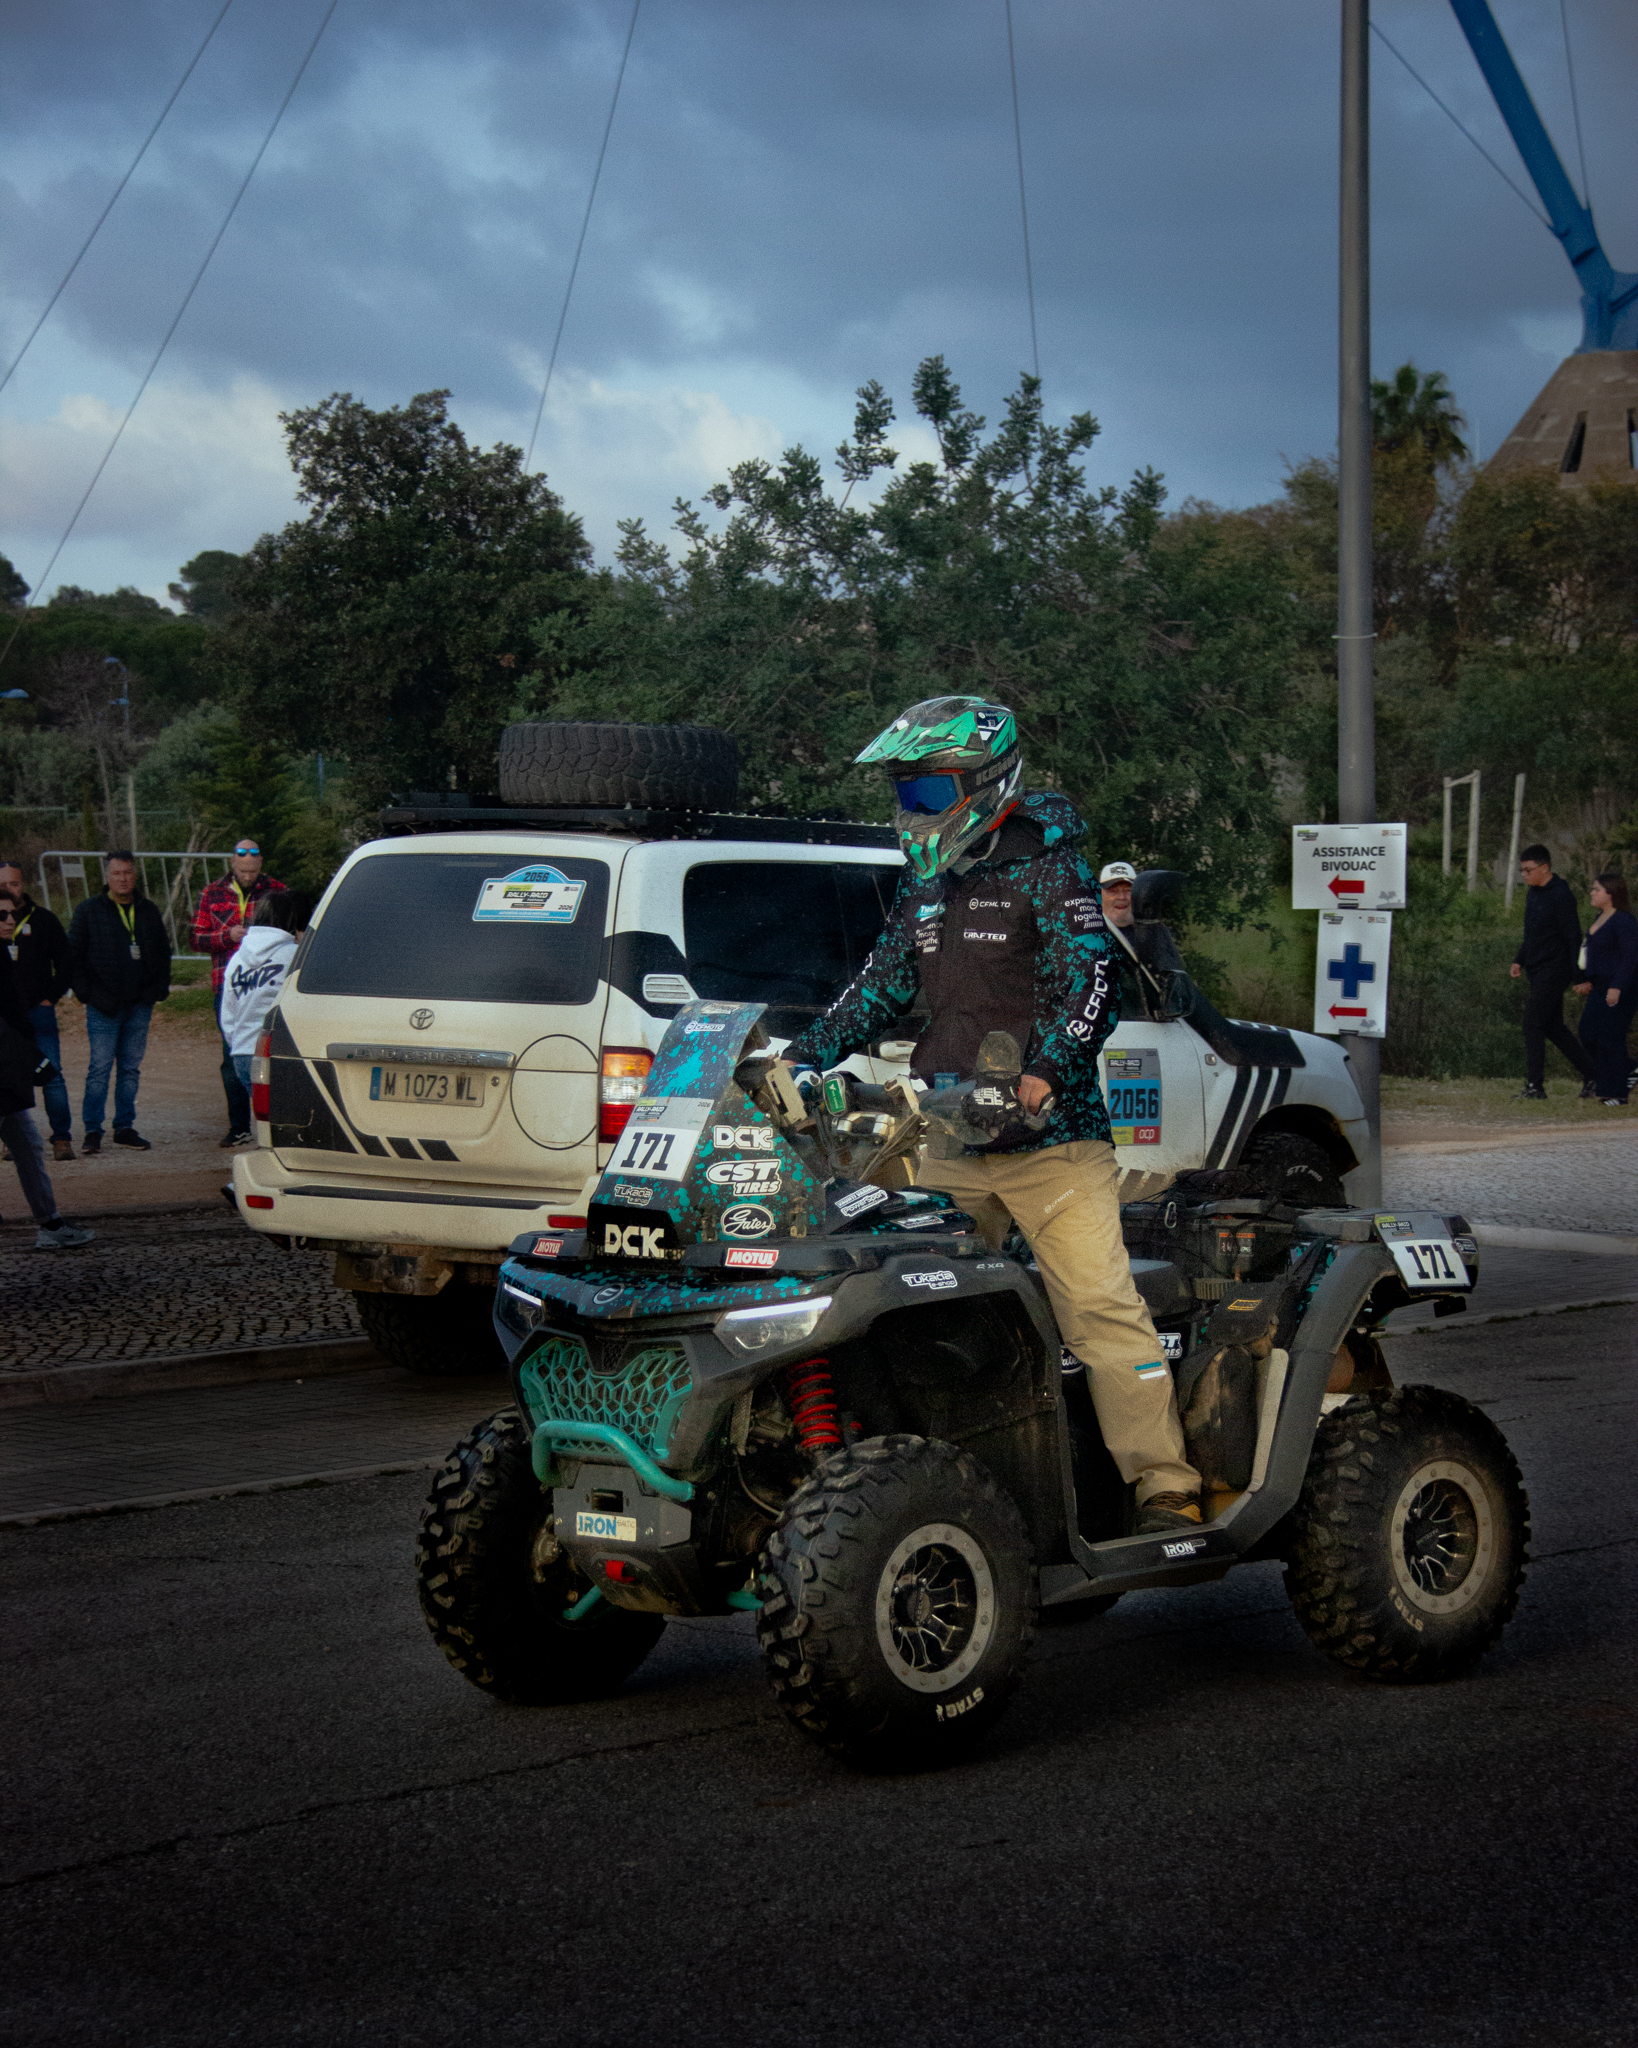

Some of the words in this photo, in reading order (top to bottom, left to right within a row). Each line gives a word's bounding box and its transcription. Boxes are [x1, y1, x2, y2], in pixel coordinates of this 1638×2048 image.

[1312, 846, 1386, 857] ASSISTANCE
[1321, 861, 1376, 871] BIVOUAC
[523, 872, 549, 882] 2056
[964, 932, 1007, 941] CRAFTED
[403, 1050, 481, 1064] CRUISER
[384, 1072, 396, 1096] M
[405, 1073, 448, 1098] 1073
[1110, 1088, 1159, 1120] 2056
[714, 1126, 773, 1150] DCK
[620, 1132, 676, 1171] 171
[708, 1161, 780, 1183] CST
[1285, 1164, 1309, 1176] STT
[735, 1181, 780, 1195] TIRES
[725, 1209, 771, 1234] Gates
[538, 1241, 560, 1254] MOTUL
[604, 1223, 665, 1259] DCK
[729, 1251, 775, 1265] MOTUL
[1405, 1245, 1456, 1279] 171
[579, 1515, 616, 1536] IRON
[1164, 1541, 1194, 1555] IRON
